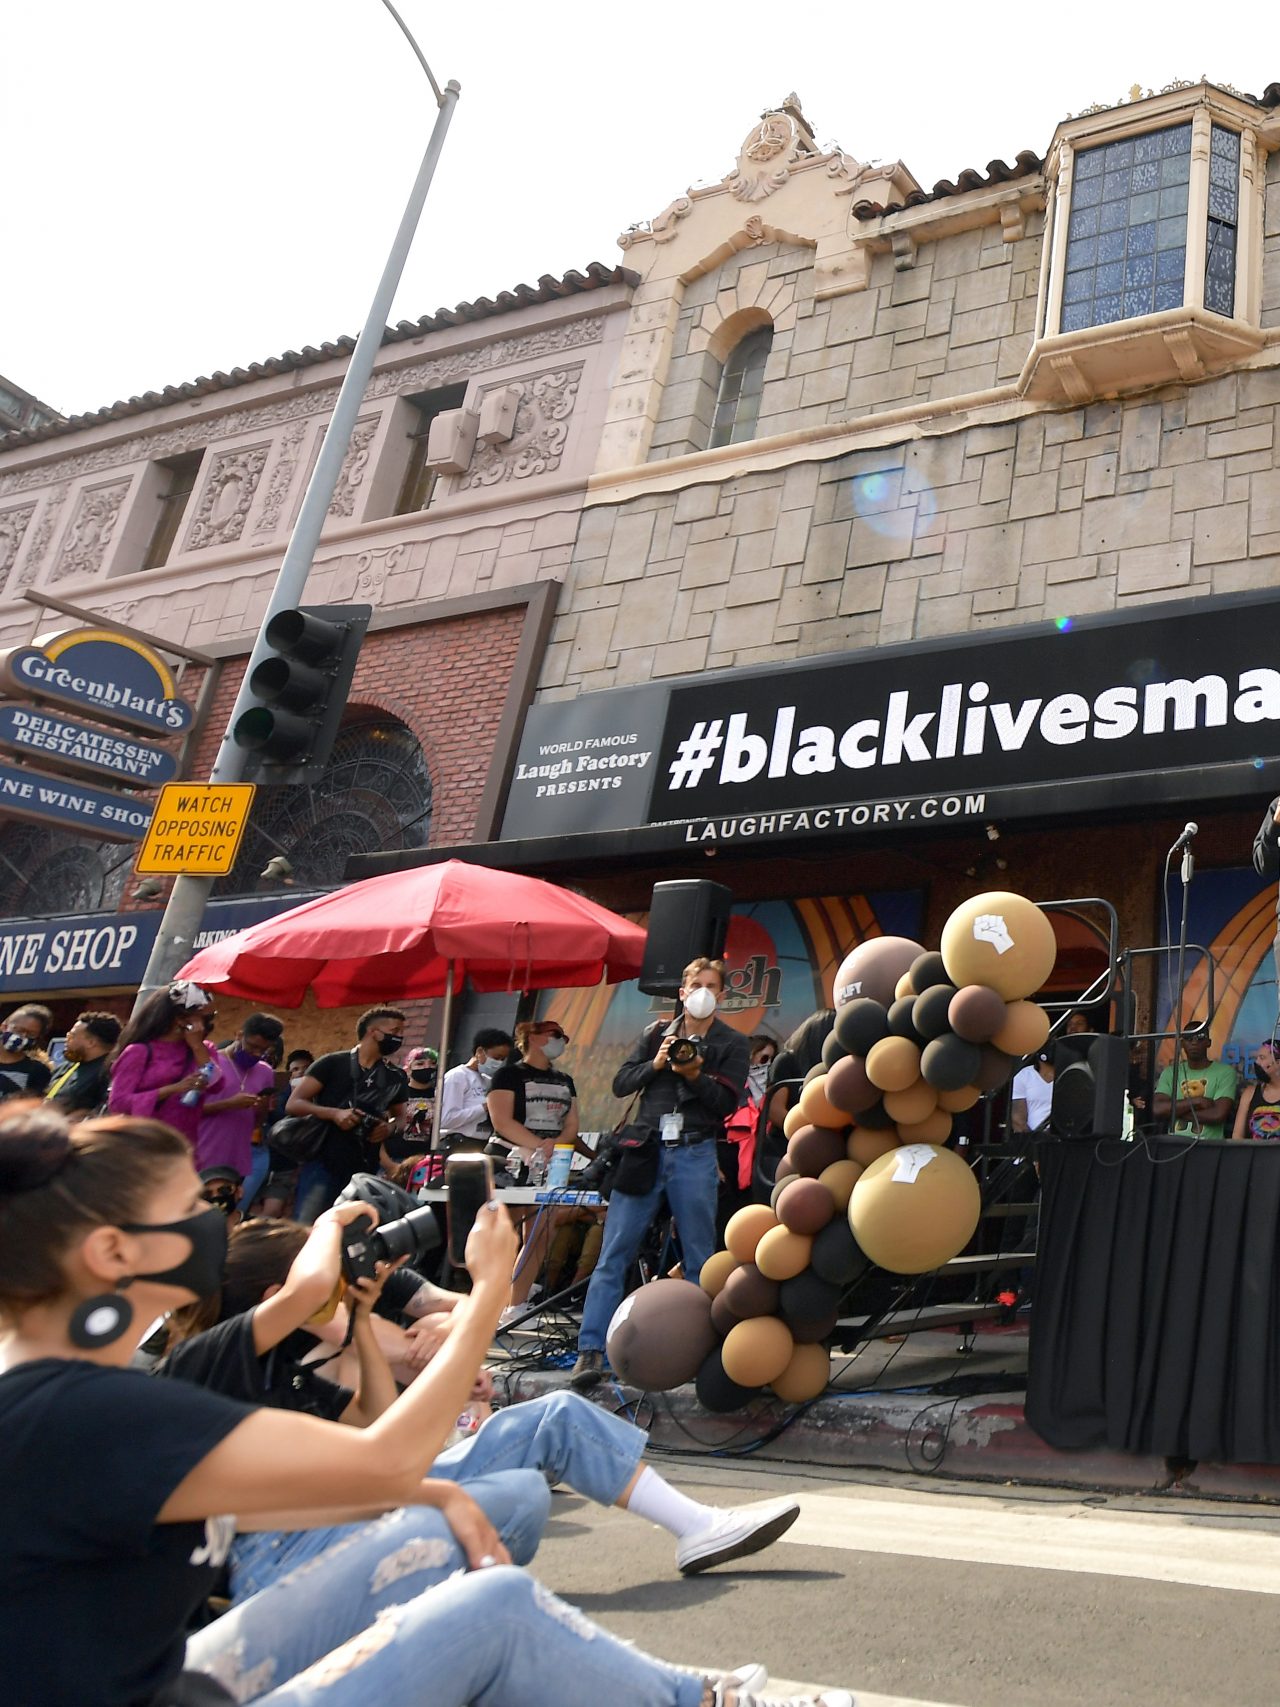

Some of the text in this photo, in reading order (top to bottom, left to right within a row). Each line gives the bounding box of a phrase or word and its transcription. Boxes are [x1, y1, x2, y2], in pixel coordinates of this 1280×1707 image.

[21, 656, 184, 728] Greenblatt's
[12, 711, 163, 766] DELICATESSEN
[15, 728, 151, 776] RESTAURANT
[539, 733, 638, 755] WORLD FAMOUS
[516, 751, 652, 780] Laugh Factory
[535, 776, 622, 797] PRESENTS
[38, 788, 96, 815] WINE
[176, 797, 233, 813] WATCH
[155, 820, 237, 837] OPPOSING
[685, 794, 986, 843] LAUGHFACTORY.COM
[153, 844, 225, 861] TRAFFIC
[0, 925, 137, 976] NE SHOP
